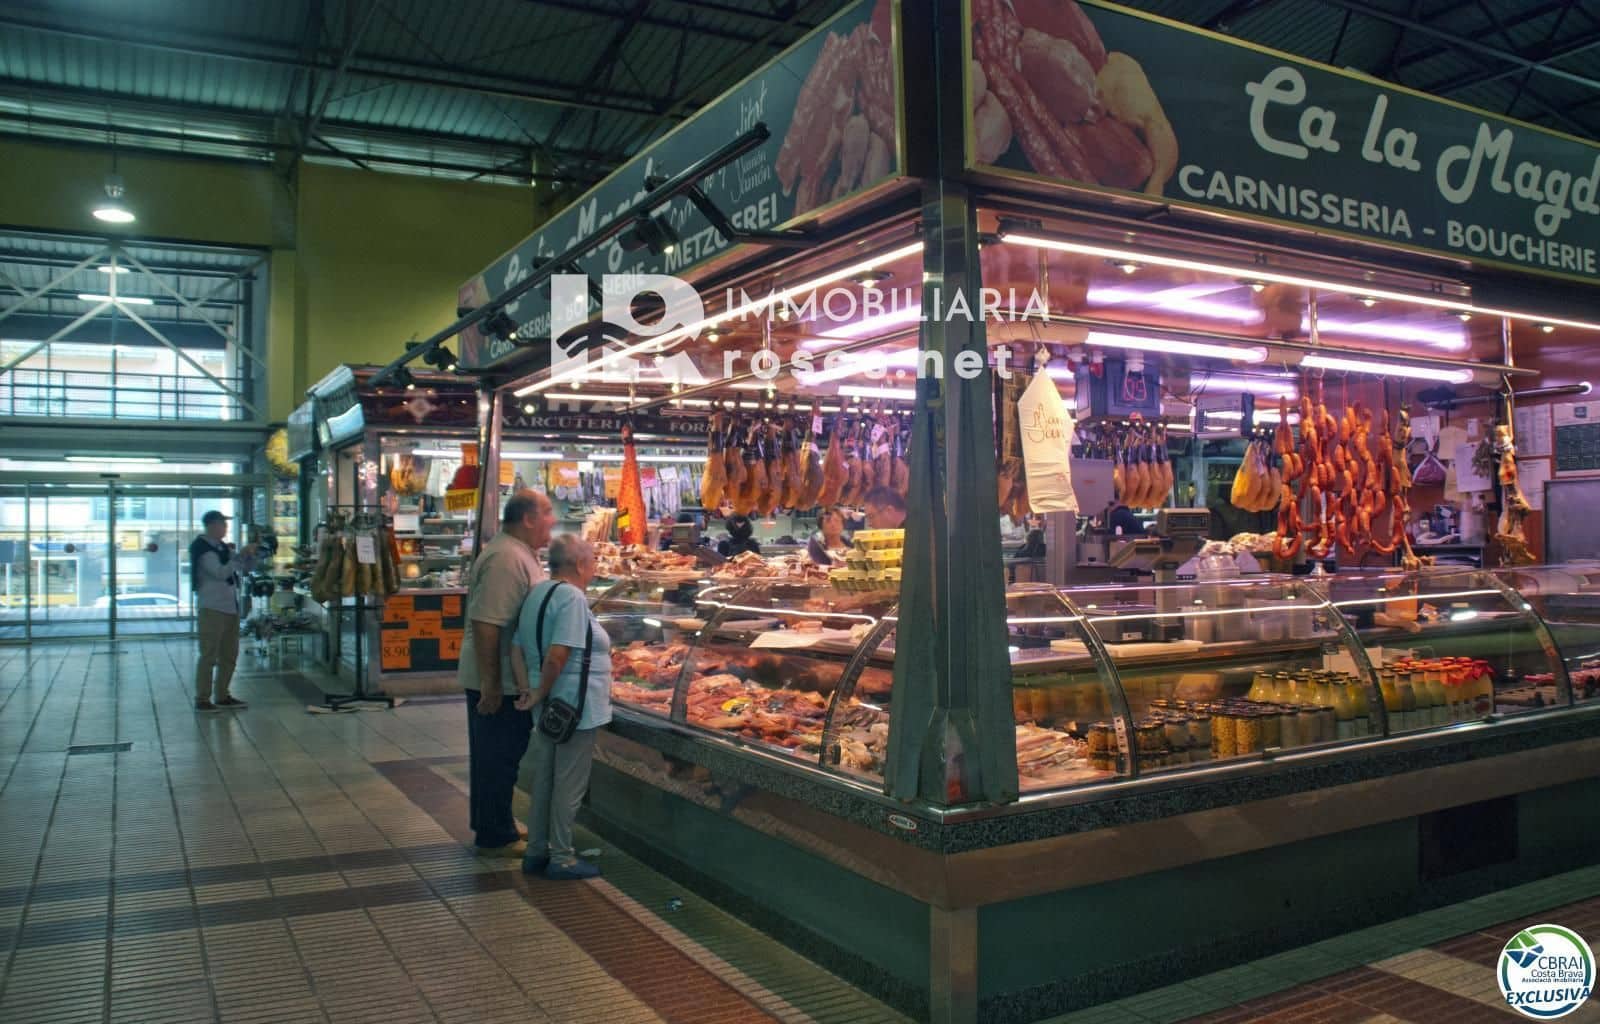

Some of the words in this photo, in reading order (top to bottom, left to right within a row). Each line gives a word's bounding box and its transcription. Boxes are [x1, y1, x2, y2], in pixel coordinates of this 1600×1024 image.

[1245, 66, 1340, 160] Ca
[1361, 94, 1421, 172] la
[1178, 164, 1413, 239] CARNISSERIA
[1446, 220, 1597, 274] BOUCHERIE
